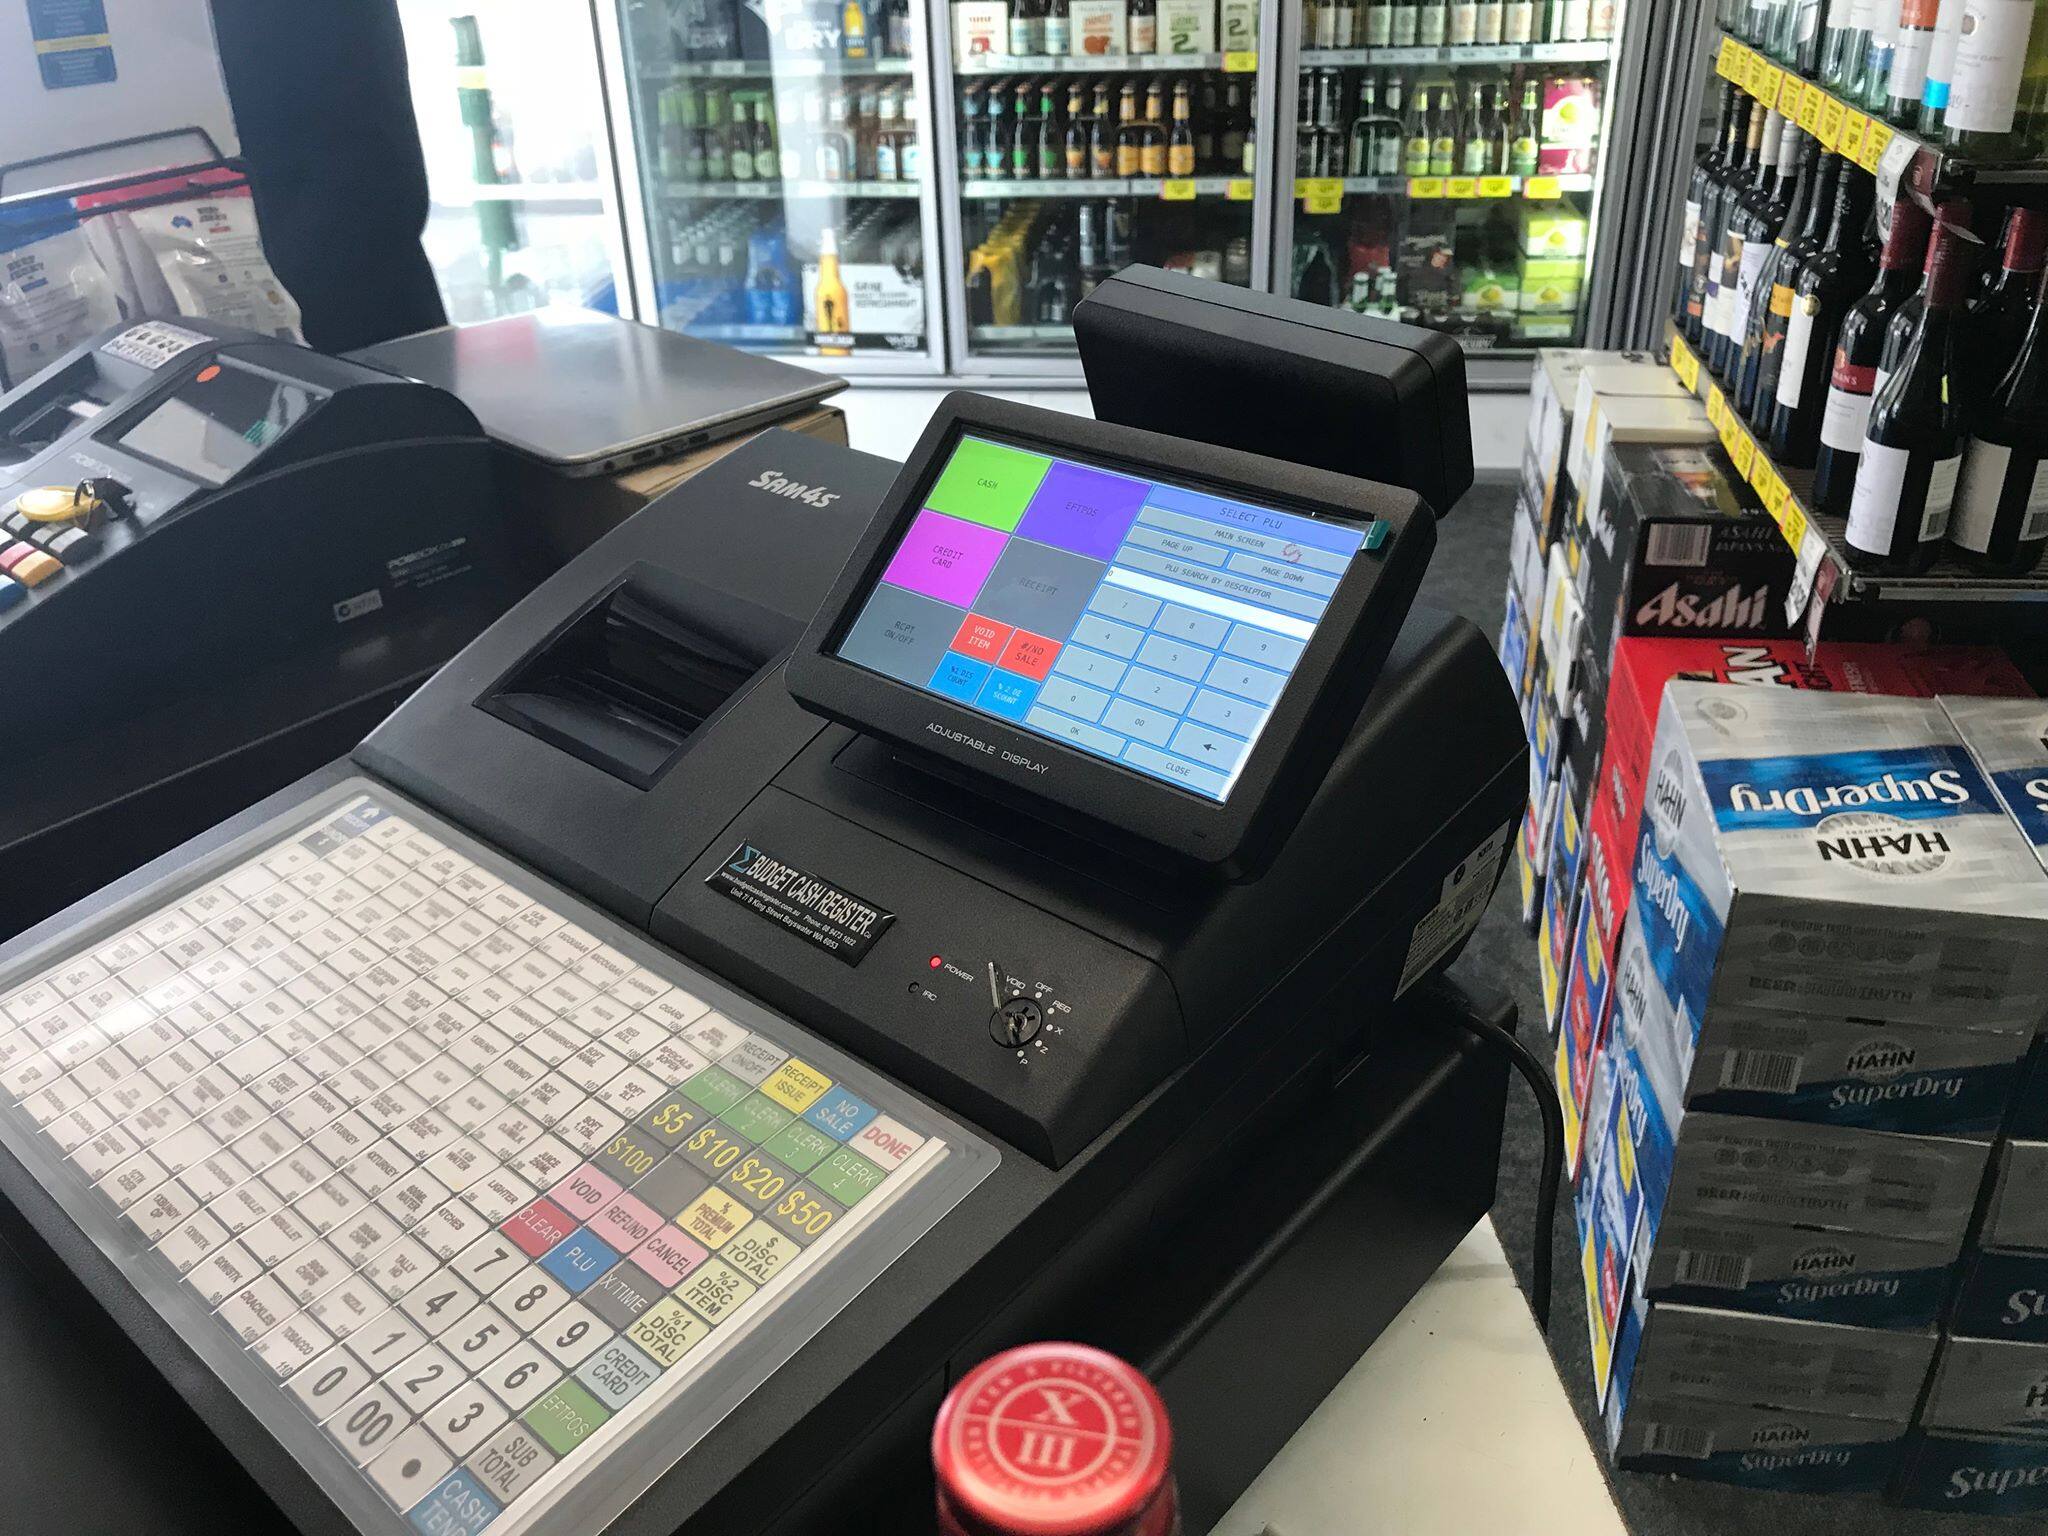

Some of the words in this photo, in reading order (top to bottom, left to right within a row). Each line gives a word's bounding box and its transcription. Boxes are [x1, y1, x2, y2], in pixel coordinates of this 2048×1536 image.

[976, 477, 999, 490] CASH
[1065, 501, 1098, 518] EFTPOS
[1219, 507, 1256, 523] SELECT
[1263, 518, 1284, 530] PLU
[1161, 539, 1178, 551] PAGE
[1181, 544, 1193, 553] UP
[1214, 530, 1234, 541] MAIN
[1236, 535, 1265, 548] SCREEN
[931, 556, 953, 570] CARD
[933, 545, 964, 560] CREDIT
[1018, 576, 1058, 596] RECEIPT
[1165, 564, 1178, 573] PLU
[1181, 567, 1209, 581] SEARCH
[1211, 575, 1222, 585] BY
[1224, 578, 1272, 600] DESCRIPTOR
[1261, 566, 1280, 578] PAGE
[1283, 572, 1305, 583] DOWN
[1636, 581, 1769, 629] Asahi
[893, 620, 915, 634] RCPT
[974, 625, 996, 639] VOID
[1105, 633, 1112, 641] 4
[1189, 622, 1195, 631] 8
[968, 636, 990, 650] ITEM
[1260, 643, 1267, 652] 9
[1015, 653, 1039, 667] SALE
[1172, 653, 1178, 662] 5
[1243, 677, 1249, 686] 6
[1134, 718, 1145, 727] 00
[1225, 710, 1231, 718] 3
[1070, 727, 1080, 735] OK
[926, 723, 996, 755] ADJUSTABLE
[1001, 750, 1049, 774] DISPLAY
[1165, 762, 1191, 777] CLOSE
[1655, 770, 1687, 829] HAHN
[1729, 769, 1970, 816] SuperDry
[1816, 831, 1951, 861] HAHN
[747, 856, 799, 891] BUDGET
[787, 876, 824, 911] CASH
[816, 887, 877, 935] REGISTER
[1638, 833, 1689, 954] SuperDry
[730, 886, 743, 899] Unit
[753, 897, 766, 912] King
[765, 904, 784, 919] Street
[782, 913, 813, 936] Bayswater
[812, 931, 824, 944] WA
[822, 936, 839, 949] 6053
[803, 914, 823, 929] Phone:
[944, 963, 974, 982] POWER
[1006, 975, 1026, 990] VOID
[922, 989, 938, 1001] IRC
[1035, 981, 1053, 993] OFF
[658, 1003, 684, 1020] CIGARS
[1052, 1000, 1072, 1014] REG
[1054, 1026, 1064, 1035] X
[585, 1046, 605, 1061] SOFT
[742, 1041, 781, 1066] RECEIPT
[1039, 1046, 1049, 1055] Z
[1847, 1050, 1916, 1071] HAHN
[540, 1082, 560, 1098] SOFT
[624, 1082, 646, 1096] SOFT
[702, 1072, 739, 1100] CLERK
[774, 1079, 805, 1102] ISSUE
[781, 1064, 824, 1093] RECEIPT
[1829, 1076, 1965, 1110] SuperDry
[653, 1104, 693, 1133] $5
[744, 1099, 785, 1128] CLERK
[815, 1107, 853, 1134] SALE
[835, 1099, 859, 1117] NO
[582, 1115, 603, 1131] SOFT
[679, 1129, 739, 1167] $10
[785, 1147, 799, 1158] 3
[787, 1127, 829, 1156] CLERK
[863, 1126, 911, 1160] DONE
[601, 1137, 653, 1173] $100
[723, 1159, 784, 1199] $20
[828, 1154, 878, 1187] CLERK
[487, 1180, 518, 1204] LIGHTER
[569, 1177, 602, 1204] VOID
[832, 1178, 847, 1190] 4
[514, 1205, 561, 1243] CLEAR
[605, 1205, 648, 1239] REFUND
[695, 1203, 734, 1234] PREMIUM
[777, 1191, 832, 1234] $50
[689, 1216, 716, 1240] TOTAL
[742, 1238, 778, 1265] DISC
[766, 1237, 778, 1248] $
[395, 1254, 417, 1273] TALLY
[473, 1247, 509, 1272] 7
[565, 1246, 596, 1271] PLU
[647, 1238, 691, 1275] CANCEL
[727, 1244, 774, 1280] TOTAL
[1792, 1254, 1856, 1272] HAHN
[388, 1265, 403, 1278] HO
[716, 1271, 739, 1291] %2
[514, 1284, 547, 1311] 8
[685, 1287, 721, 1316] ITEM
[697, 1276, 733, 1305] DISC
[1777, 1278, 1900, 1304] SuperDry
[240, 1290, 276, 1326] CRACKLES
[426, 1291, 457, 1316] 4
[650, 1315, 686, 1345] DISC
[669, 1310, 692, 1331] %1
[282, 1326, 312, 1355] TOBACCO
[371, 1331, 406, 1355] 1
[463, 1324, 499, 1352] 5
[556, 1321, 589, 1347] 9
[633, 1322, 683, 1364] TOTAL
[274, 1361, 293, 1378] 110
[404, 1364, 444, 1393] 2
[504, 1361, 539, 1389] 6
[604, 1348, 651, 1387] CREDIT
[312, 1366, 347, 1396] 0
[591, 1364, 630, 1397] CARD
[346, 1400, 393, 1446] 00
[448, 1402, 484, 1433] 3
[543, 1394, 593, 1438] EFTPOS
[1752, 1428, 1810, 1443] HAHN
[504, 1436, 541, 1468] SUB
[1739, 1451, 1851, 1472] SuperDry
[476, 1448, 513, 1493] TOTAL
[442, 1479, 492, 1529] CASH
